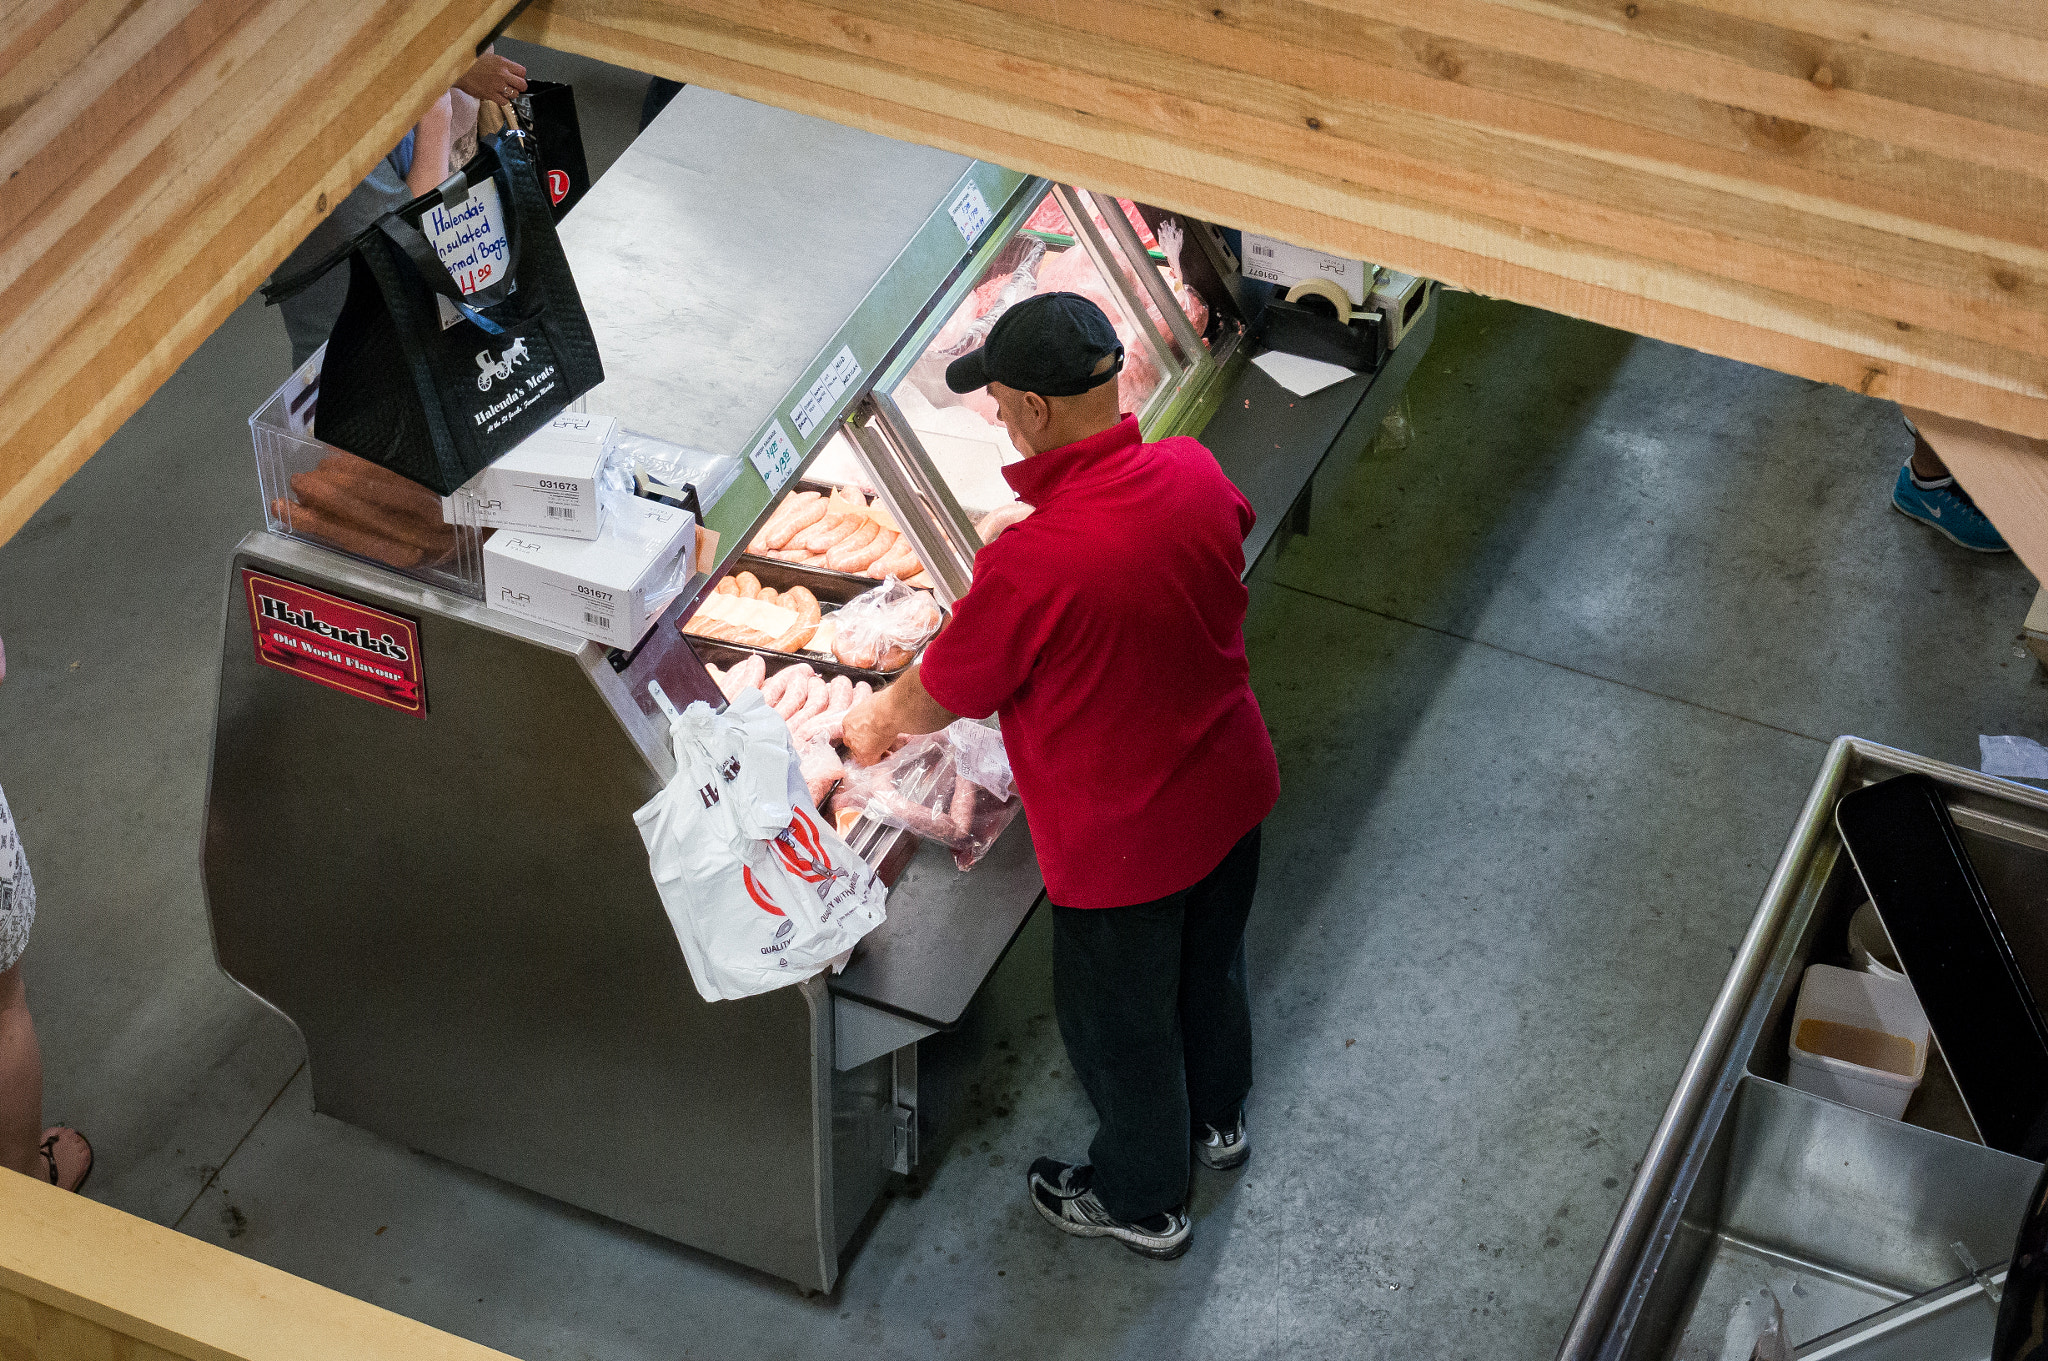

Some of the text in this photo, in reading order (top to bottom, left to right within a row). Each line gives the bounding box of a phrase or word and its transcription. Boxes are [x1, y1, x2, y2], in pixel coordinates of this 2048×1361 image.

[432, 196, 484, 236] Halenda's
[442, 236, 507, 276] ermal Bags
[1249, 268, 1278, 281] 031677
[474, 366, 555, 426] Halenda's Meats
[540, 480, 578, 491] 031673
[578, 584, 613, 601] 031677
[258, 594, 409, 662] Halenda's
[273, 632, 402, 681] Old World Flavour
[760, 939, 791, 954] QUALITY
